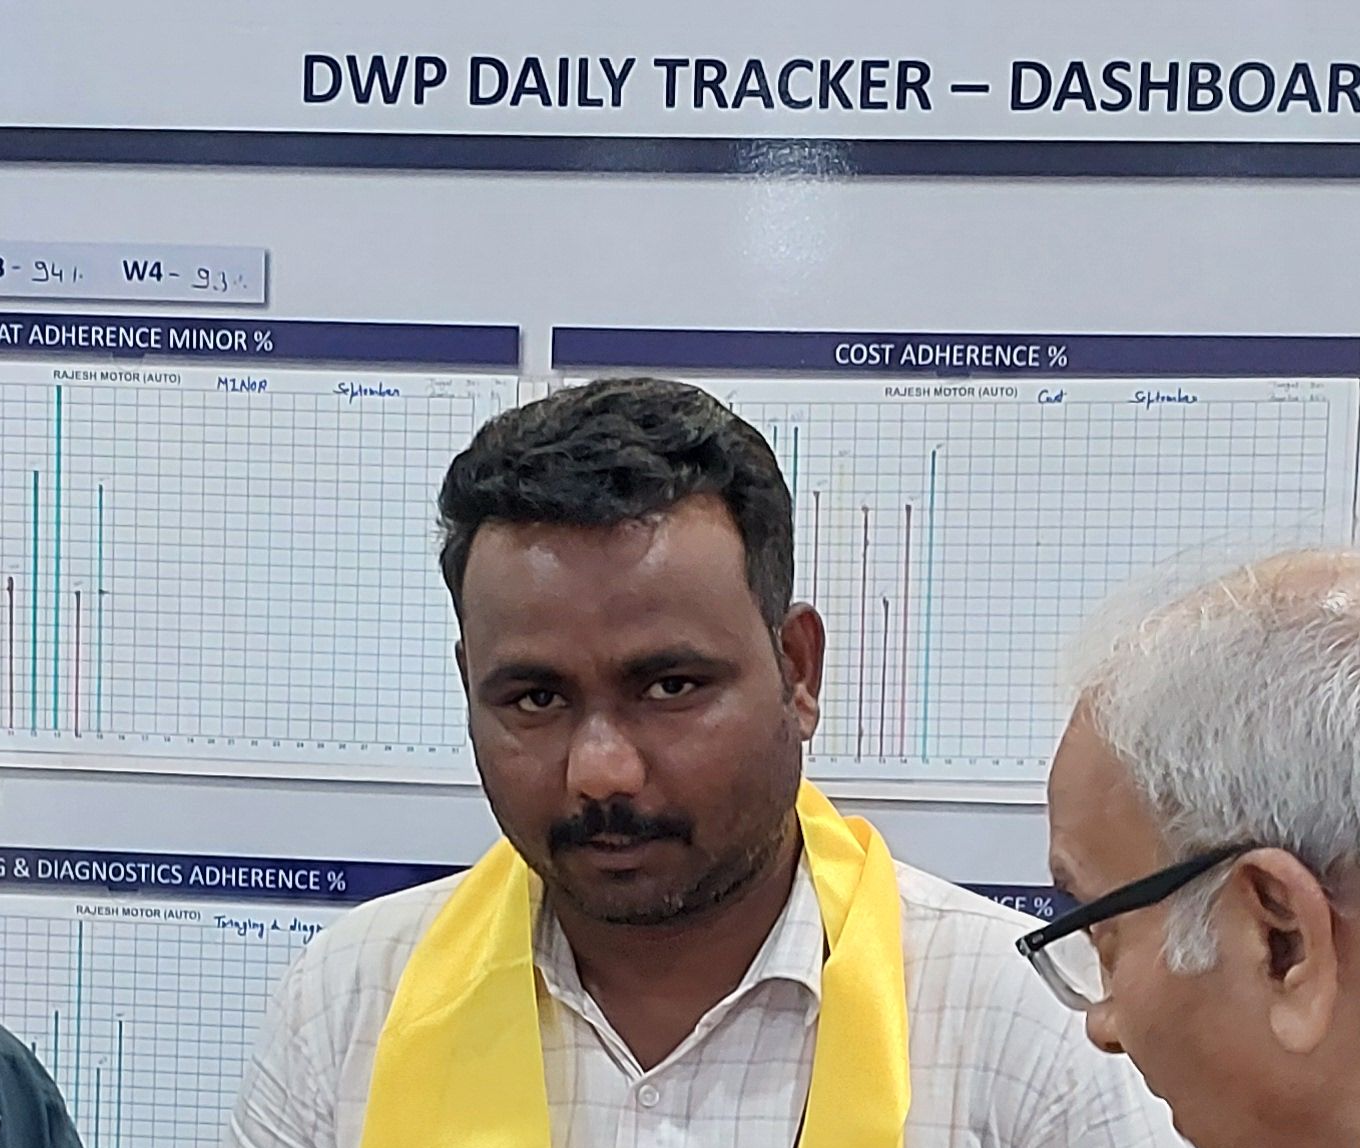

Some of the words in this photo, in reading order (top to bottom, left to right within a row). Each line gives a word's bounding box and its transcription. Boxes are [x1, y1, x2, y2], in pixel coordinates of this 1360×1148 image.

[301, 54, 448, 105] DWP
[468, 56, 636, 107] DAILY
[654, 58, 933, 111] TRACKER
[122, 259, 164, 282] W4
[29, 325, 162, 349] ADHERENCE
[169, 328, 248, 351] MINOR
[253, 331, 274, 351] %
[835, 343, 894, 365] COST
[900, 344, 1041, 368] ADHERENCE
[1048, 346, 1068, 367] %
[53, 370, 97, 381] RAJESH
[100, 372, 140, 382] MOTOR
[143, 373, 181, 385] (AUTO)
[885, 387, 930, 397] RAJESH
[933, 387, 975, 397] MOTOR
[978, 387, 1018, 399] (AUTO)
[13, 857, 30, 878] &
[37, 860, 183, 885] DIAGNOSTICS
[190, 864, 320, 890] ADHERENCE
[326, 871, 346, 891] %
[76, 904, 119, 917] RAJESH
[122, 906, 161, 918] MOTOR
[164, 908, 201, 922] (AUTO)
